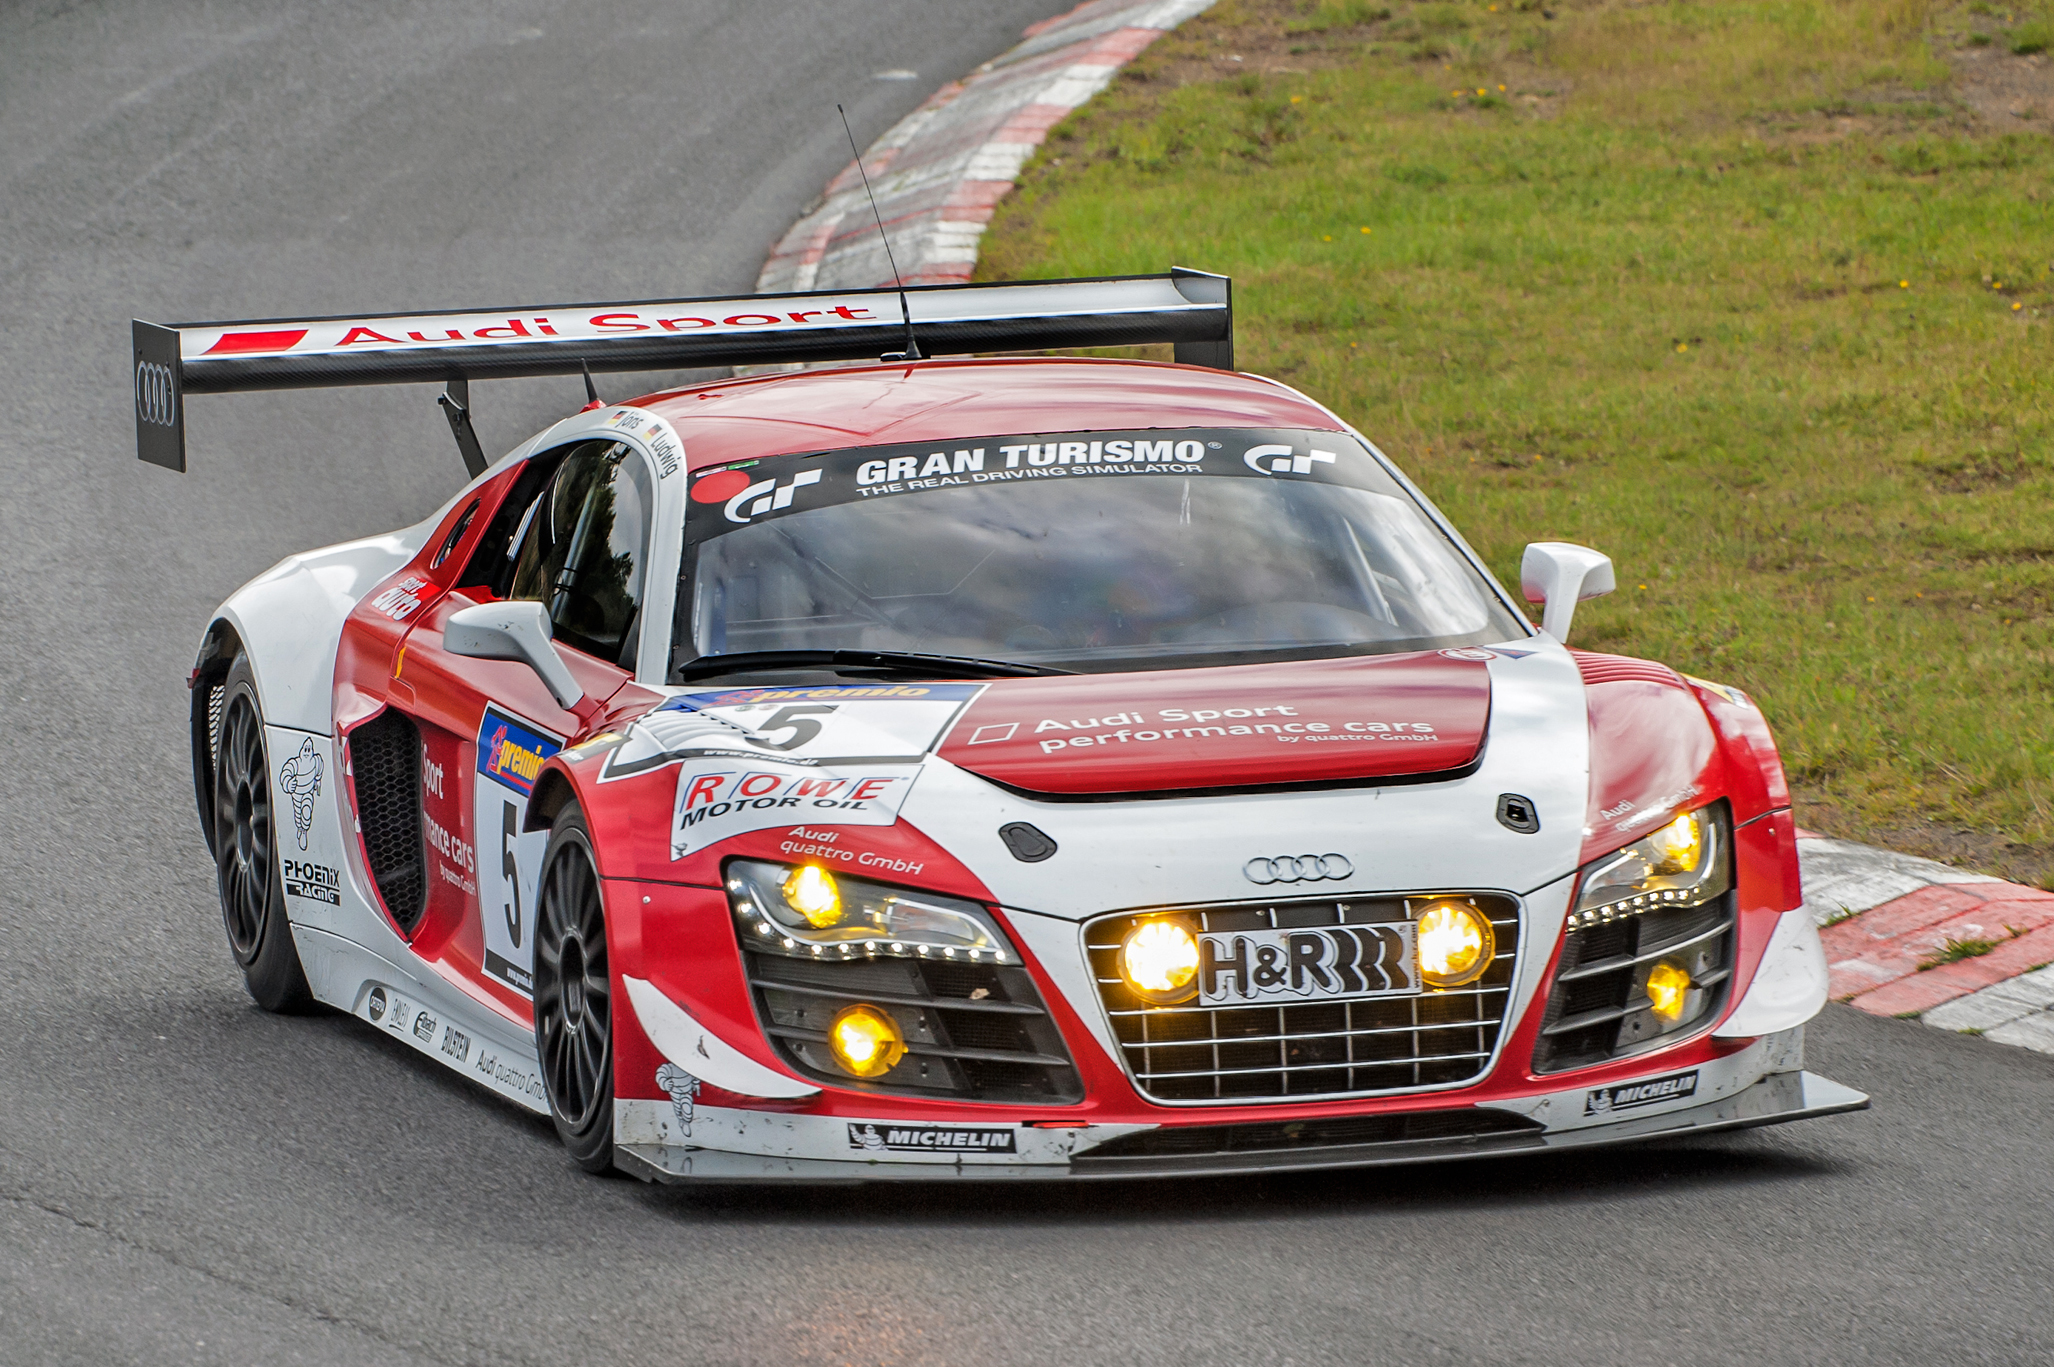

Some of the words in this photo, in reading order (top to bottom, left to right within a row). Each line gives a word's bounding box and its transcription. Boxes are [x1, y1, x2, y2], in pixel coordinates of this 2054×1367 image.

[334, 317, 560, 347] Audi
[589, 305, 877, 333] Sport
[650, 432, 682, 480] Ludwig
[856, 448, 985, 486] GRAN
[999, 440, 1206, 469] TURISMO
[856, 483, 905, 497] THE
[908, 476, 970, 491] REAL
[972, 465, 1067, 483] DRIVING
[1071, 463, 1204, 476] SIMULATOR
[371, 587, 421, 620] auto
[750, 686, 931, 703] premio
[745, 705, 839, 751] 5
[1034, 711, 1145, 734] Audi
[1158, 704, 1299, 723] Sport
[1038, 721, 1331, 754] performance
[1343, 721, 1435, 733] cars
[1277, 734, 1299, 743] by
[1305, 733, 1375, 743] quattro
[1379, 733, 1439, 742] GmbH
[423, 743, 444, 800] Sport
[703, 749, 819, 767] www.premio.de
[685, 774, 894, 812] ROWE
[1600, 799, 1636, 820] Audi
[680, 797, 801, 830] MOTOR
[813, 799, 869, 811] OIL
[789, 826, 840, 844] Audi
[451, 836, 475, 873] cars
[780, 840, 855, 861] quattro
[858, 852, 924, 876] GmbH
[502, 799, 521, 949] 5
[441, 1026, 471, 1063] BILSTEIN
[475, 1049, 498, 1076] Audi
[495, 1062, 526, 1091] quattro
[526, 1073, 547, 1102] Gmb
[1614, 1074, 1697, 1104] MICHELIN
[887, 1128, 1011, 1147] MICHELIN
